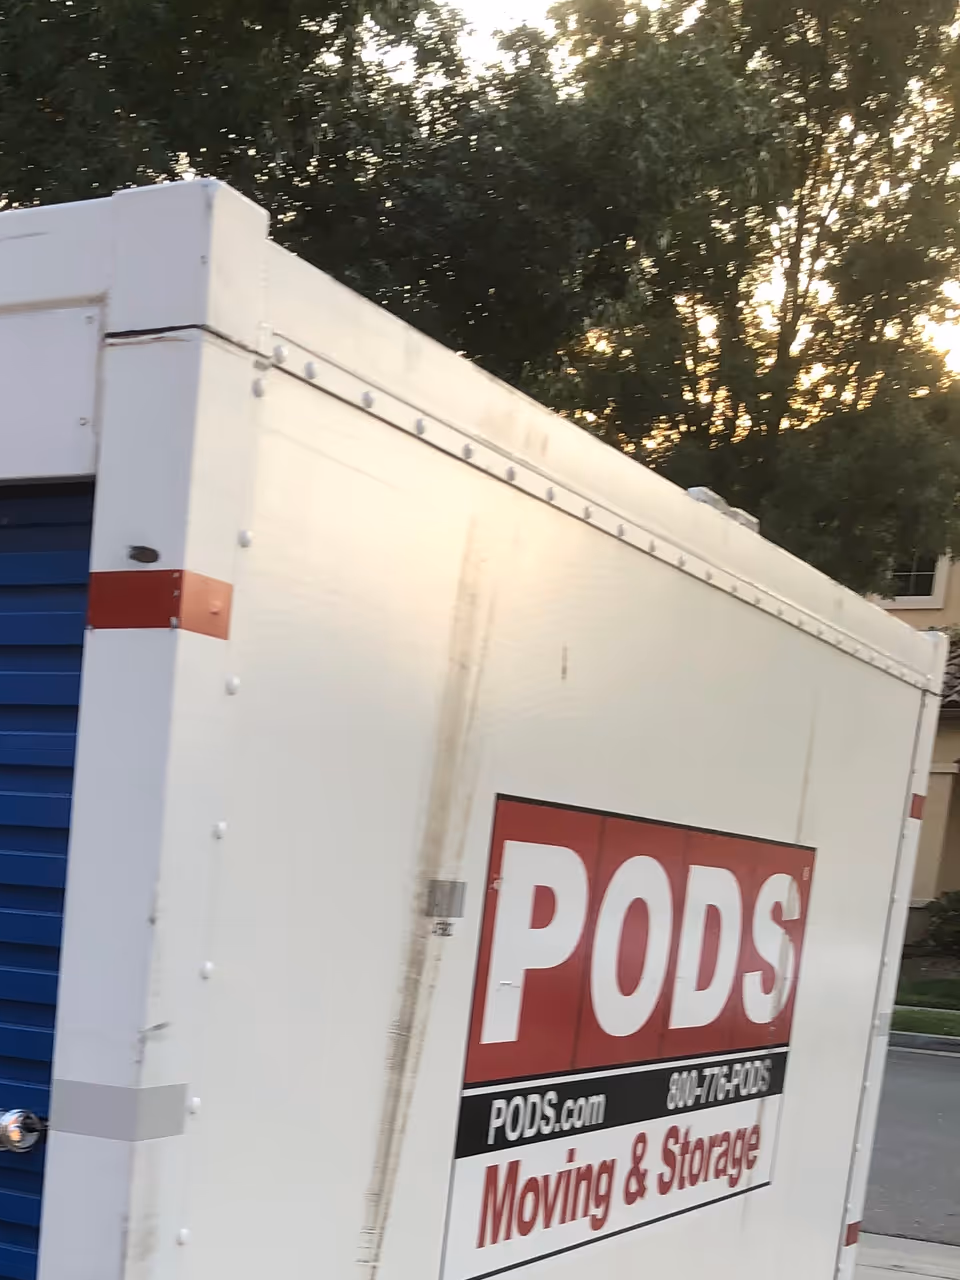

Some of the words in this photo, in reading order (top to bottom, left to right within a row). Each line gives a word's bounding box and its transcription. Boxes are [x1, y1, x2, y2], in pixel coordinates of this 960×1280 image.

[479, 839, 802, 1044] PODS
[487, 1090, 607, 1145] PODS.com
[666, 1059, 772, 1110] 800-776-PODS
[476, 1147, 617, 1249] Moving
[623, 1132, 649, 1205] &
[657, 1124, 761, 1196] Storage
